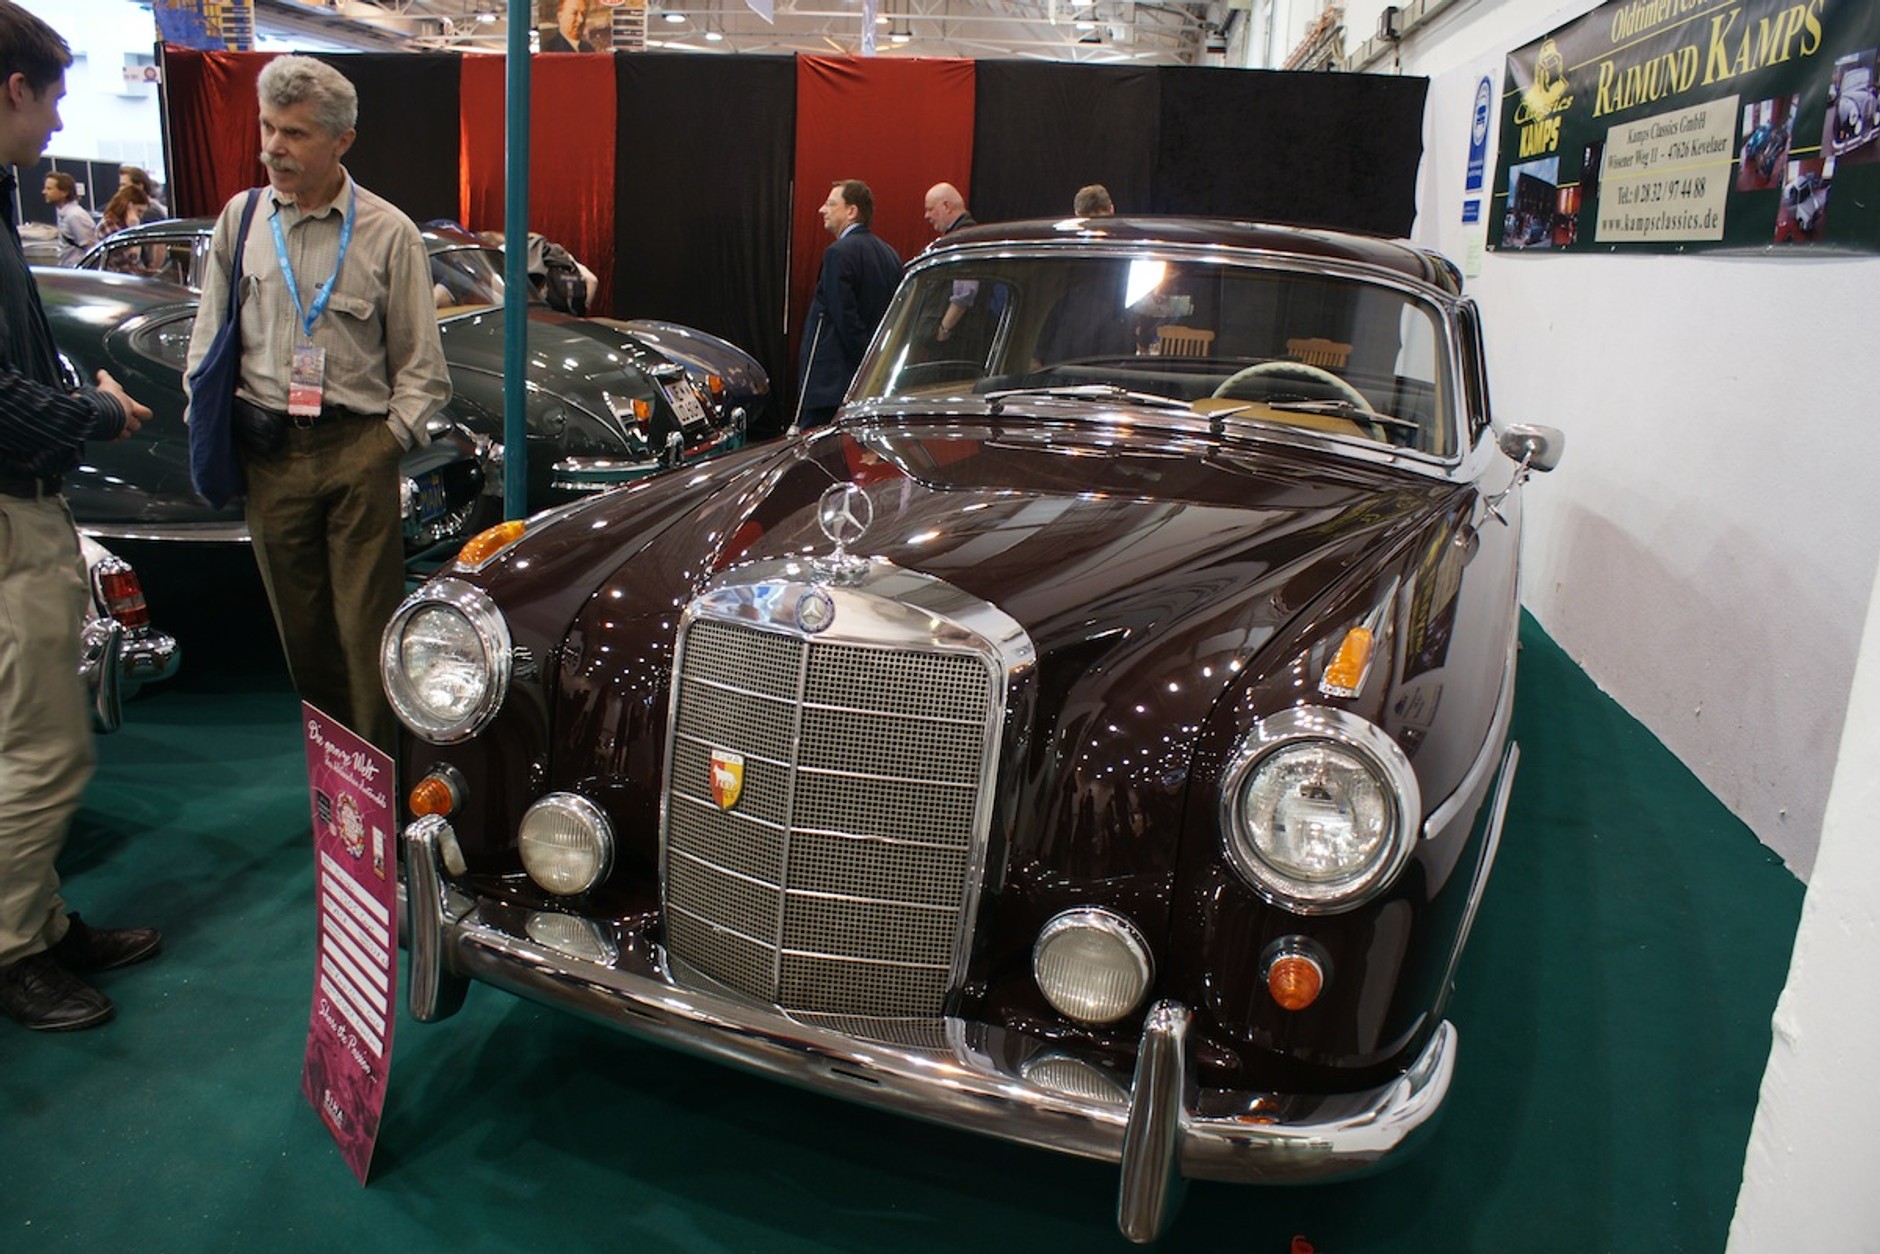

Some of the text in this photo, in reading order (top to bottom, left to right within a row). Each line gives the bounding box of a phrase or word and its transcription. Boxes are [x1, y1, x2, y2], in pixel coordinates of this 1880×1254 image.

[1592, 0, 1824, 118] RAIMUND KAMPS
[1519, 115, 1562, 158] KAMPS
[1627, 111, 1706, 145] Kamps Classics GmbH
[1635, 149, 1649, 168] Weg
[1691, 135, 1728, 157] Kevelaer
[1602, 208, 1718, 236] www.kampsclassics.de
